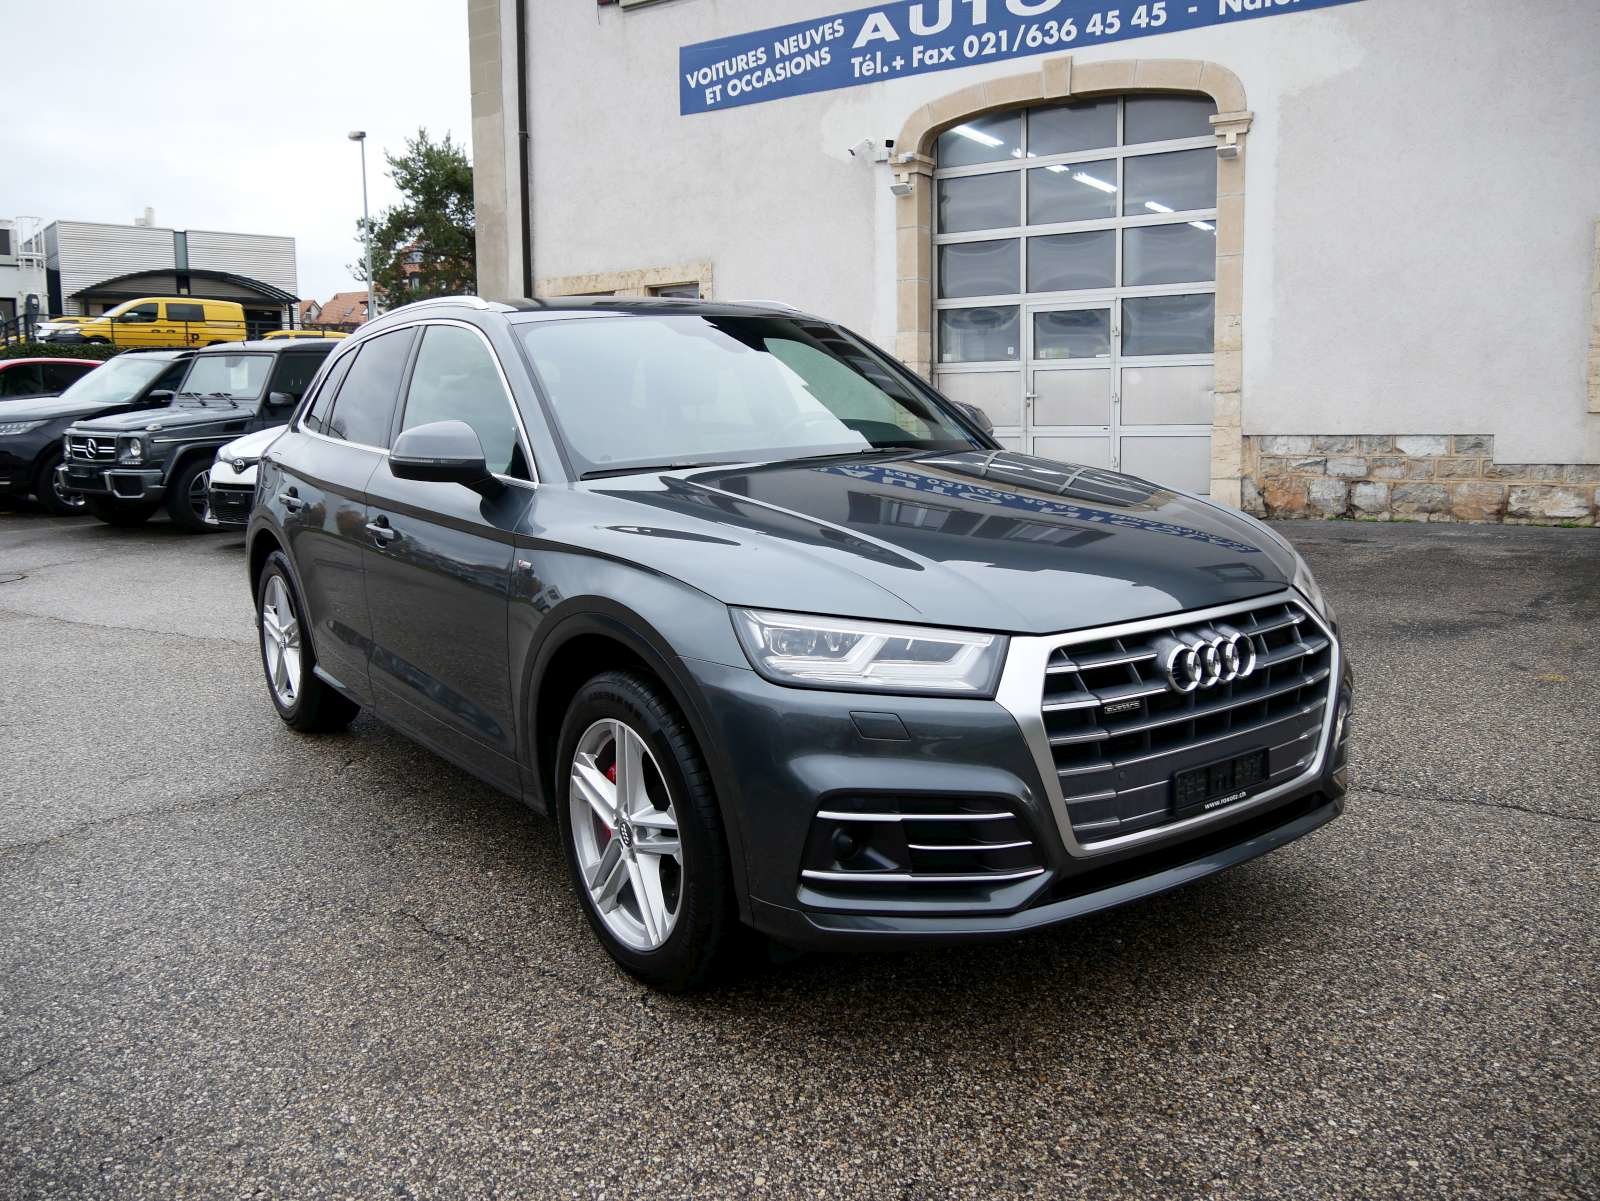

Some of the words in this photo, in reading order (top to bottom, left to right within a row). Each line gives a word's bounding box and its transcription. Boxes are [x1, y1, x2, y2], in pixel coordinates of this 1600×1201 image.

[686, 47, 767, 89] VOITURES
[774, 19, 845, 58] NEUVES
[912, 45, 956, 68] Fax
[963, 18, 1078, 58] 021/636
[1085, 9, 1121, 36] 45
[1130, 2, 1168, 28] 45
[705, 84, 722, 105] ET
[727, 47, 831, 97] OCCASIONS
